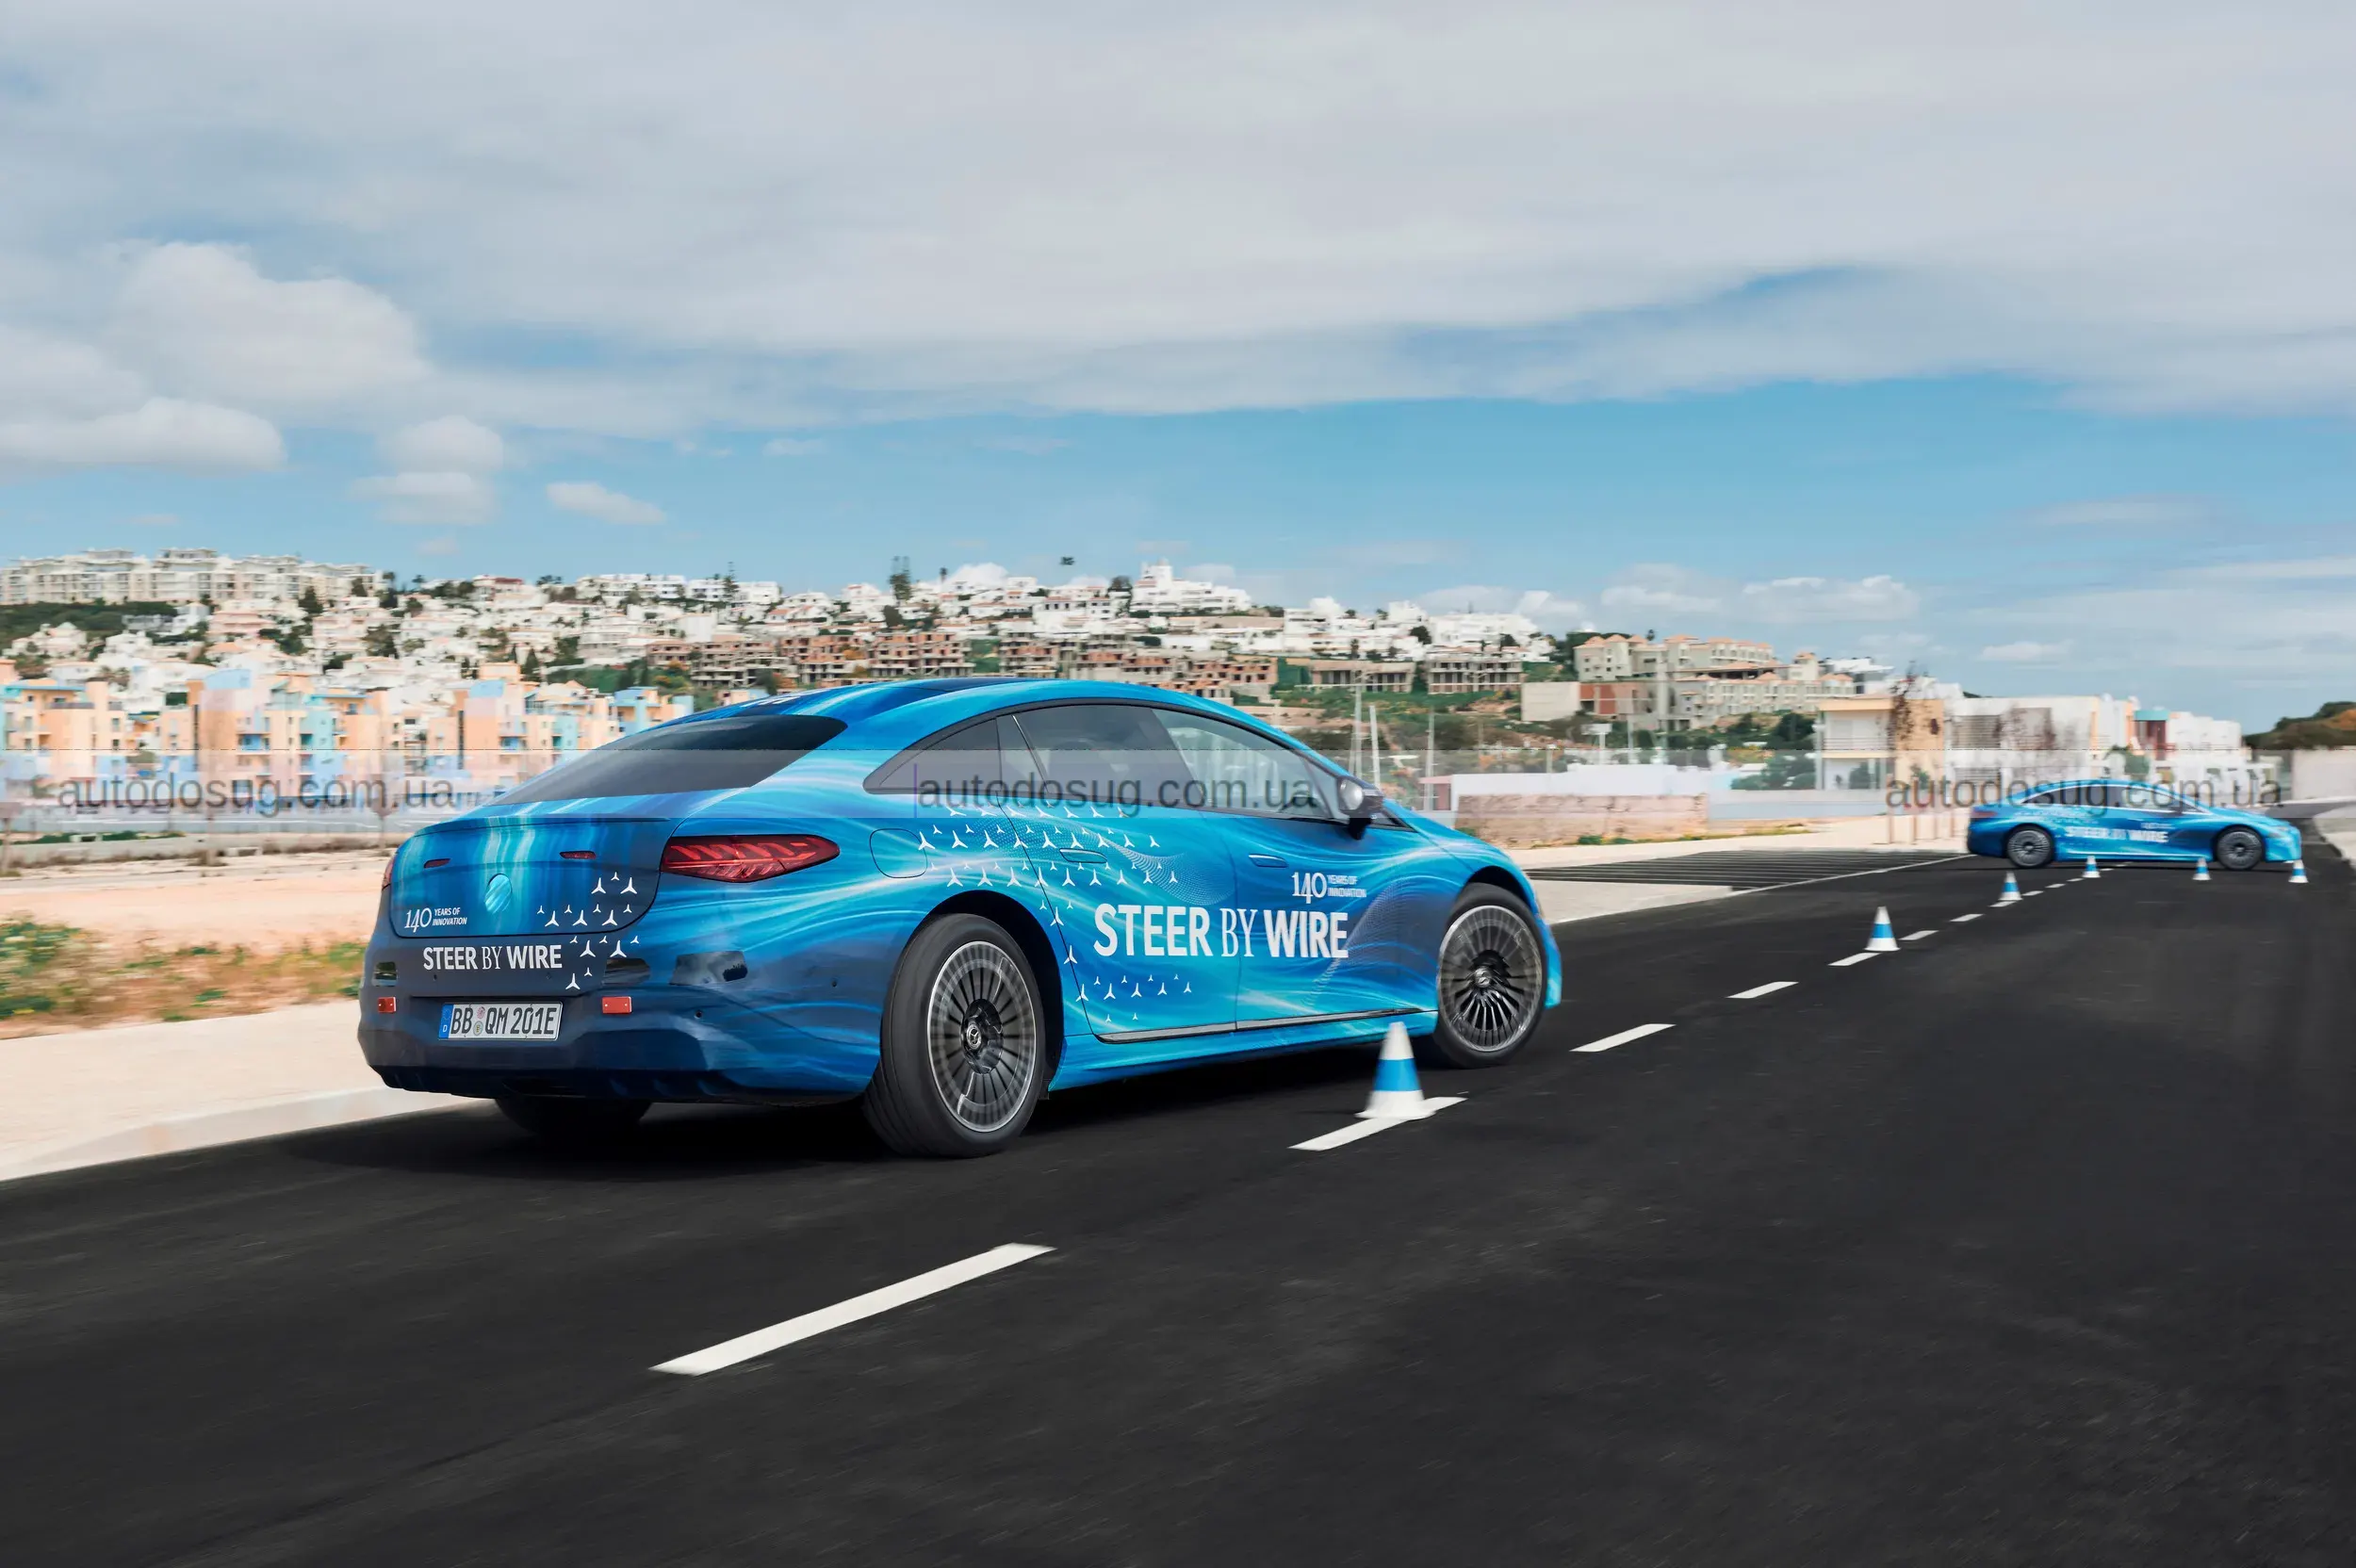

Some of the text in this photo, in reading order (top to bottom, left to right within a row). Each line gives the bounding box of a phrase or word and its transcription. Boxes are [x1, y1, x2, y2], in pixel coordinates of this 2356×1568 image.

[1291, 872, 1327, 904] 140
[403, 906, 433, 933] 140
[432, 917, 467, 926] INNOVATION
[434, 906, 461, 917] YEARS OF
[1093, 903, 1349, 958] STEER BY WIRE
[423, 944, 563, 971] STEER BY WIRE
[442, 1024, 448, 1033] D
[450, 1006, 558, 1035] BB QM 201E
